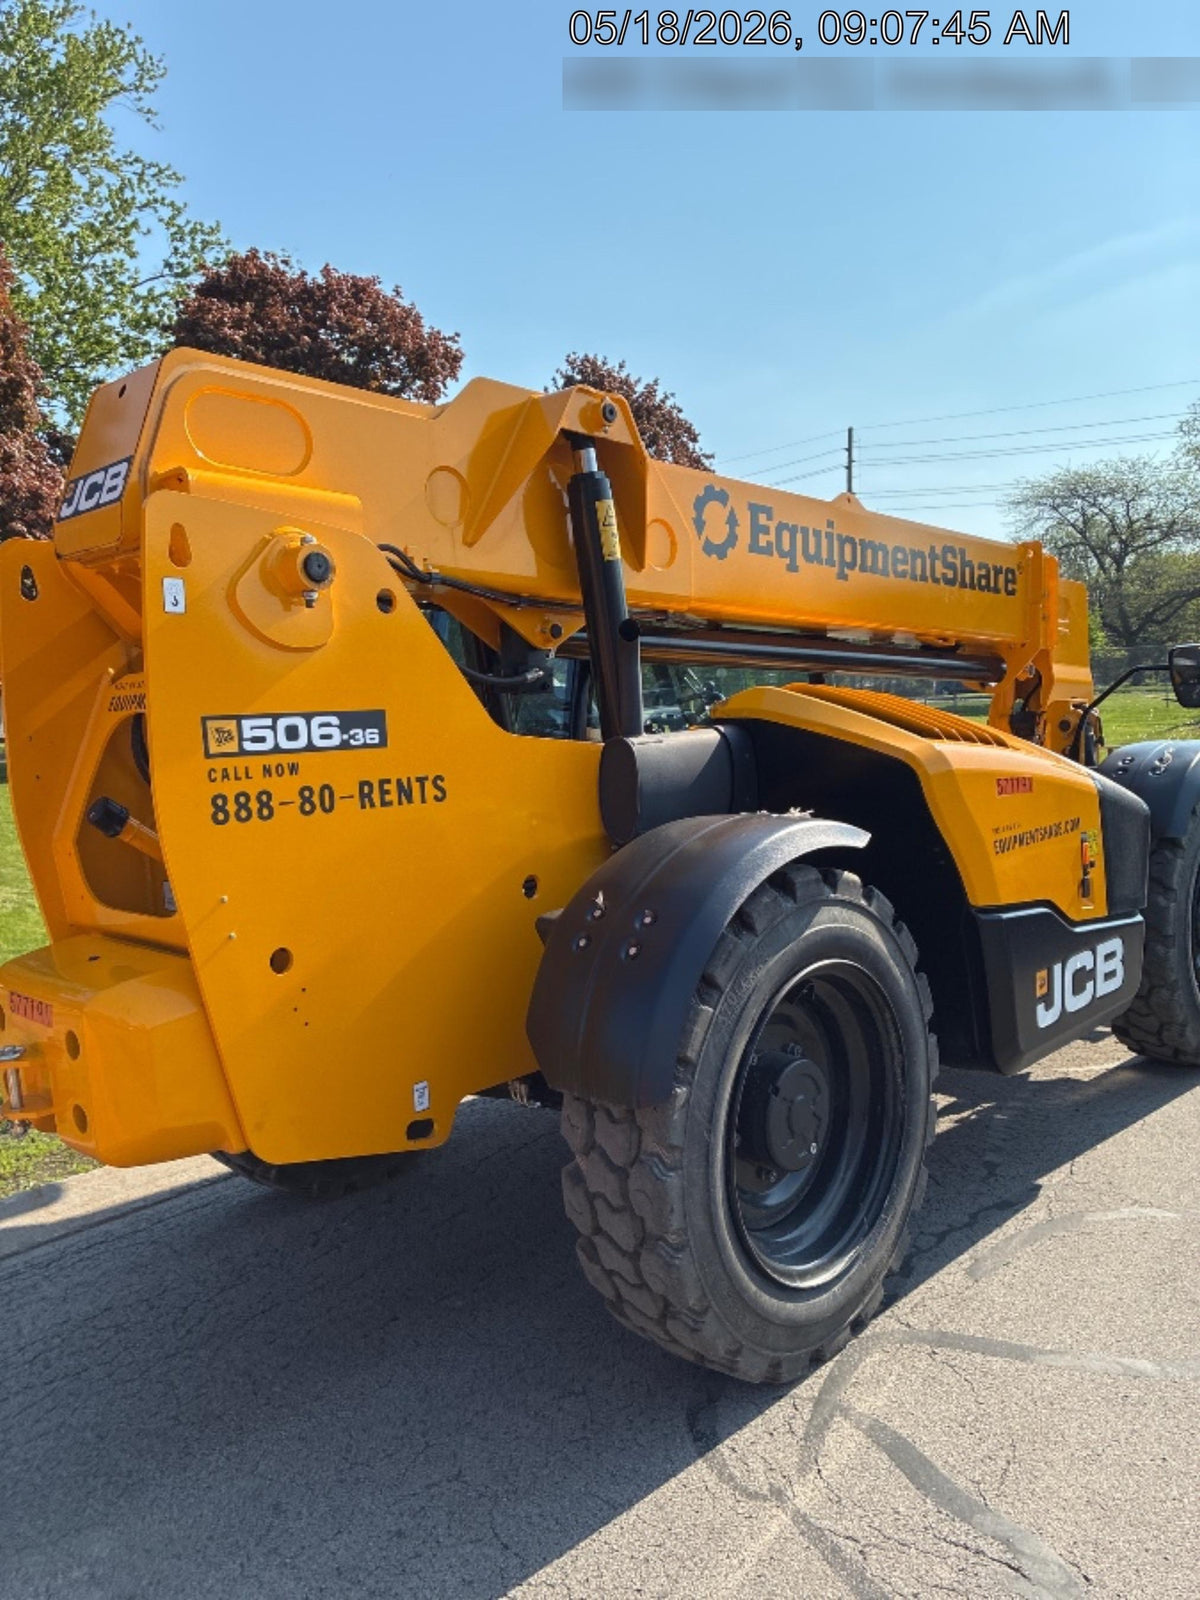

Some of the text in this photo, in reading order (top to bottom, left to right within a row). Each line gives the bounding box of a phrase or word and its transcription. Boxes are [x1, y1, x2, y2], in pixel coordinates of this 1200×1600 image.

[60, 461, 129, 519] JCB
[747, 501, 1018, 597] EquipmentShare
[240, 715, 380, 751] 506-36
[207, 761, 300, 783] CALL NOW
[210, 774, 448, 826] 888-80-RENTS
[1036, 937, 1125, 1029] JCB
